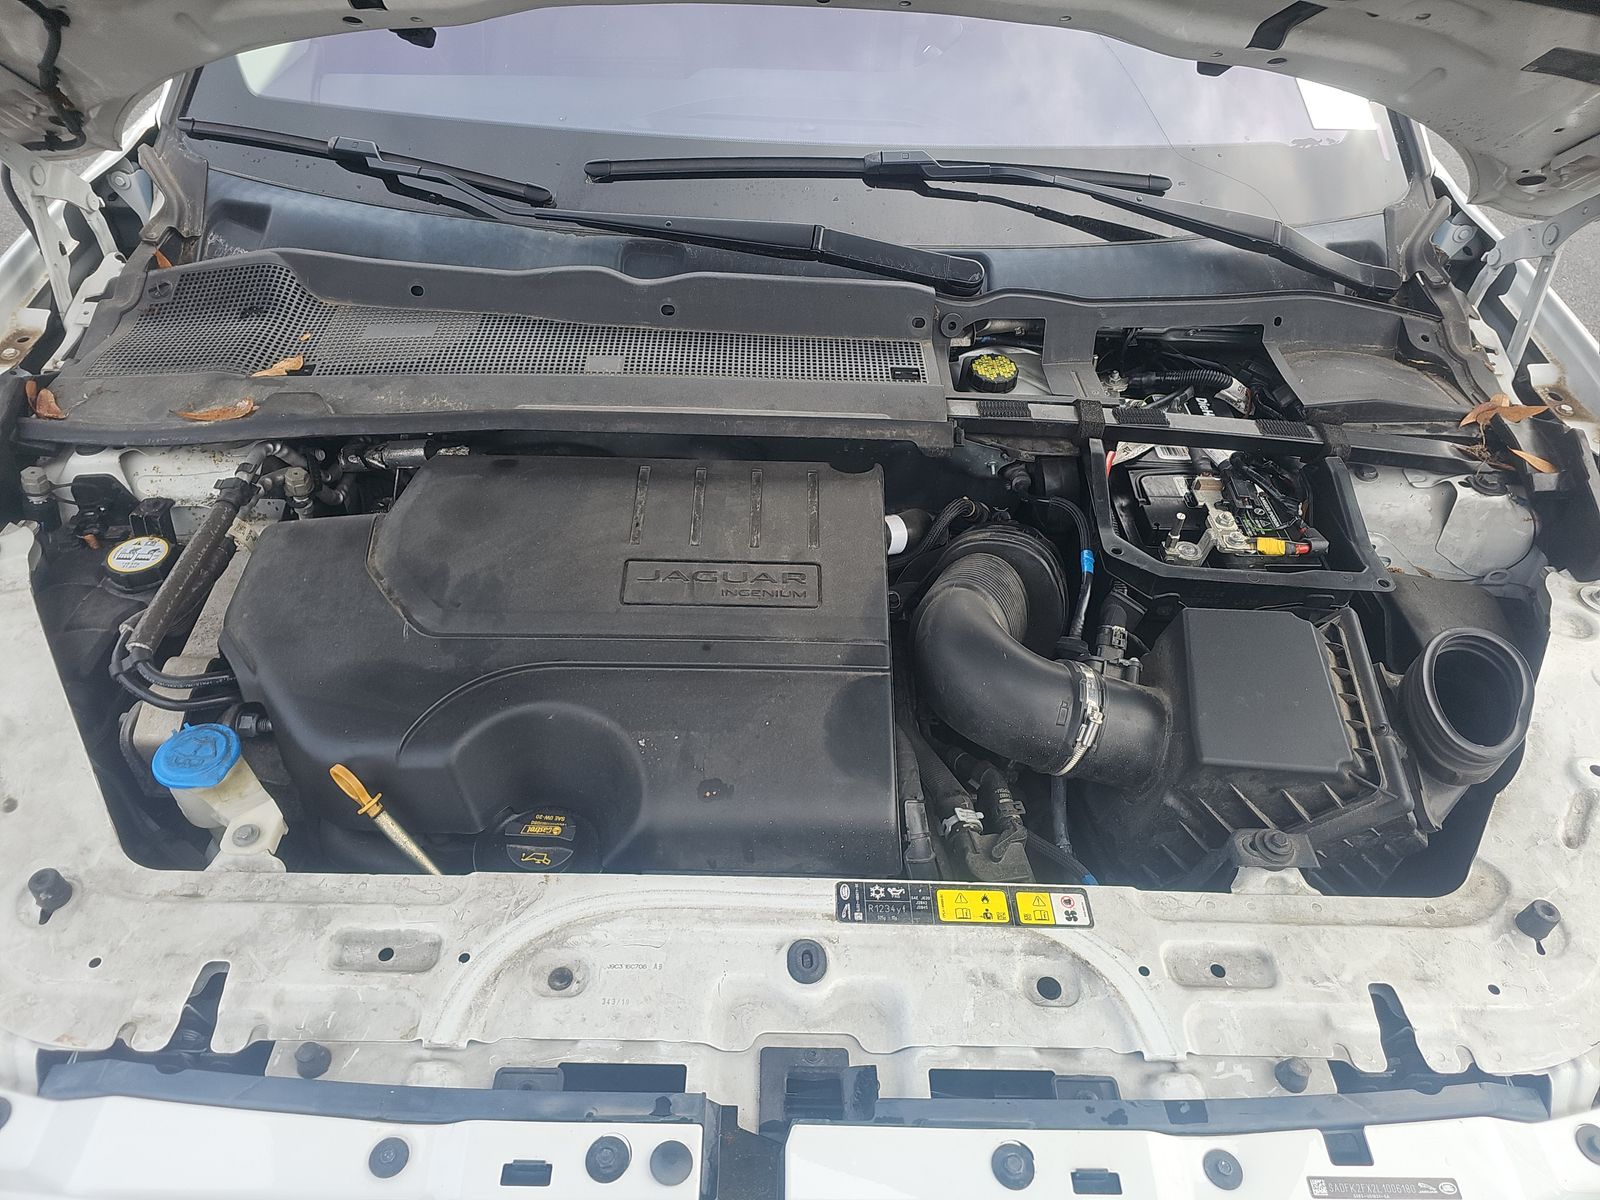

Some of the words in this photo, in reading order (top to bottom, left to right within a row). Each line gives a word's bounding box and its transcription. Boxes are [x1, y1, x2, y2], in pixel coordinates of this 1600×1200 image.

[636, 569, 807, 585] JAGUAR
[721, 589, 807, 598] INGENIUM
[527, 826, 552, 834] Castrol
[868, 904, 907, 914] R1234yf
